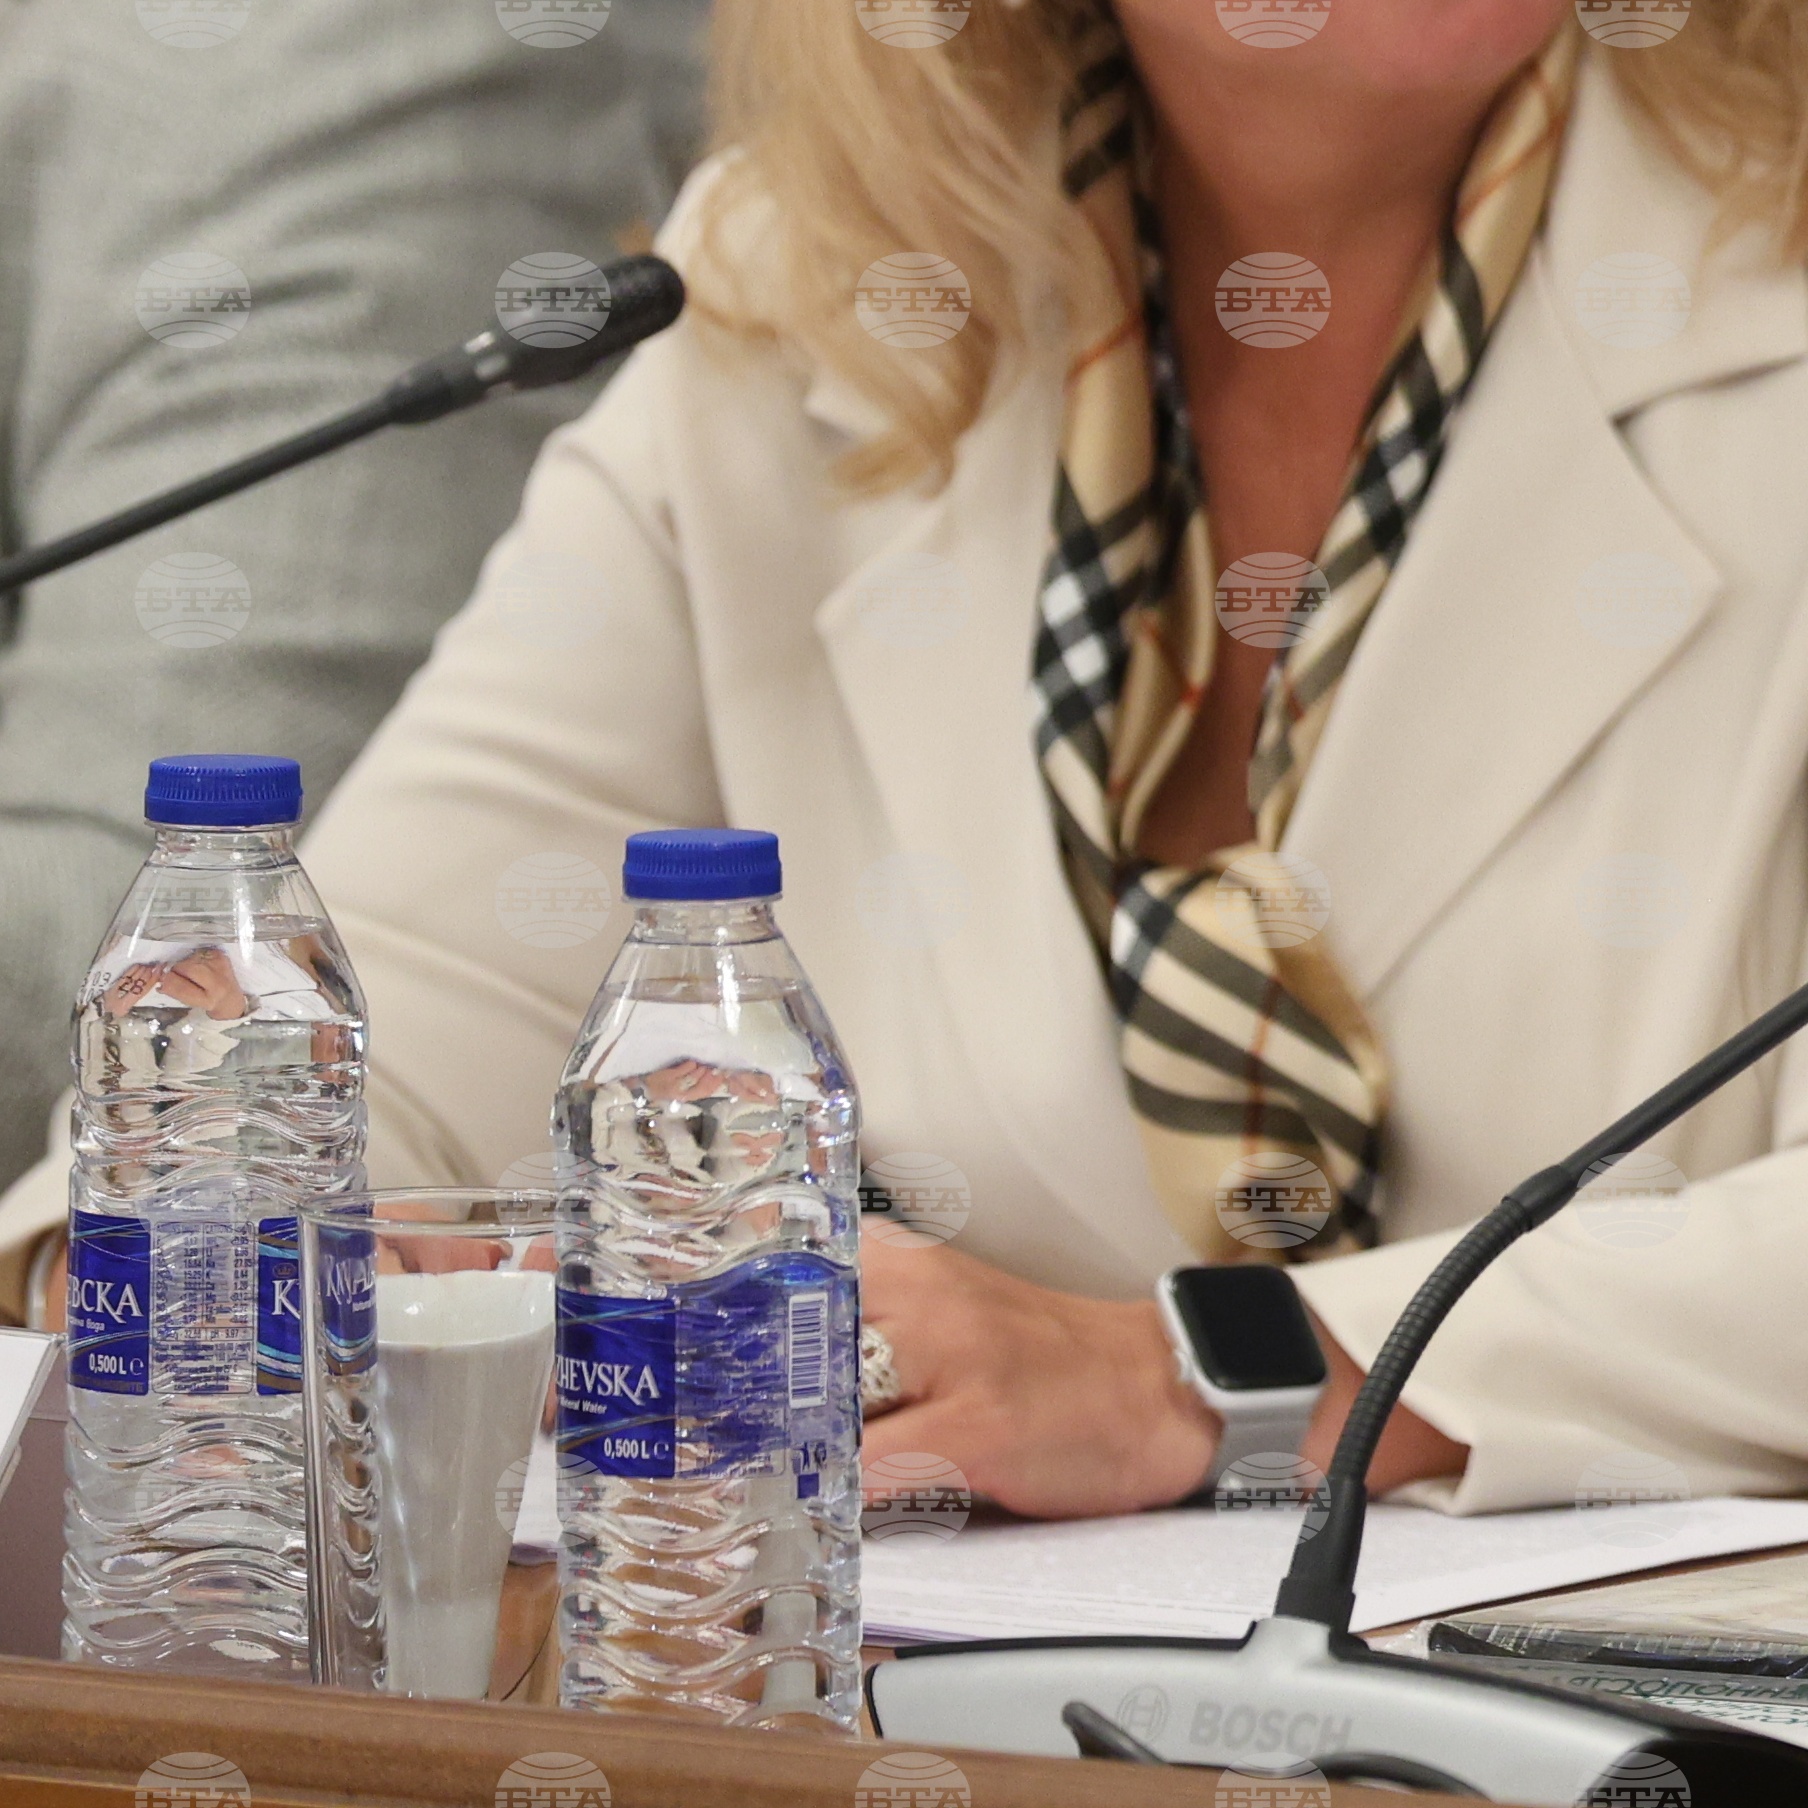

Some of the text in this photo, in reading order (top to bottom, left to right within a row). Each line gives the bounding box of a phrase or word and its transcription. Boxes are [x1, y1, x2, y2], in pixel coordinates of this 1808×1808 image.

[67, 1274, 144, 1323] ВСКА
[89, 1353, 117, 1373] 0,500
[603, 1438, 639, 1460] 0,500
[1189, 1700, 1352, 1754] BOSCH
